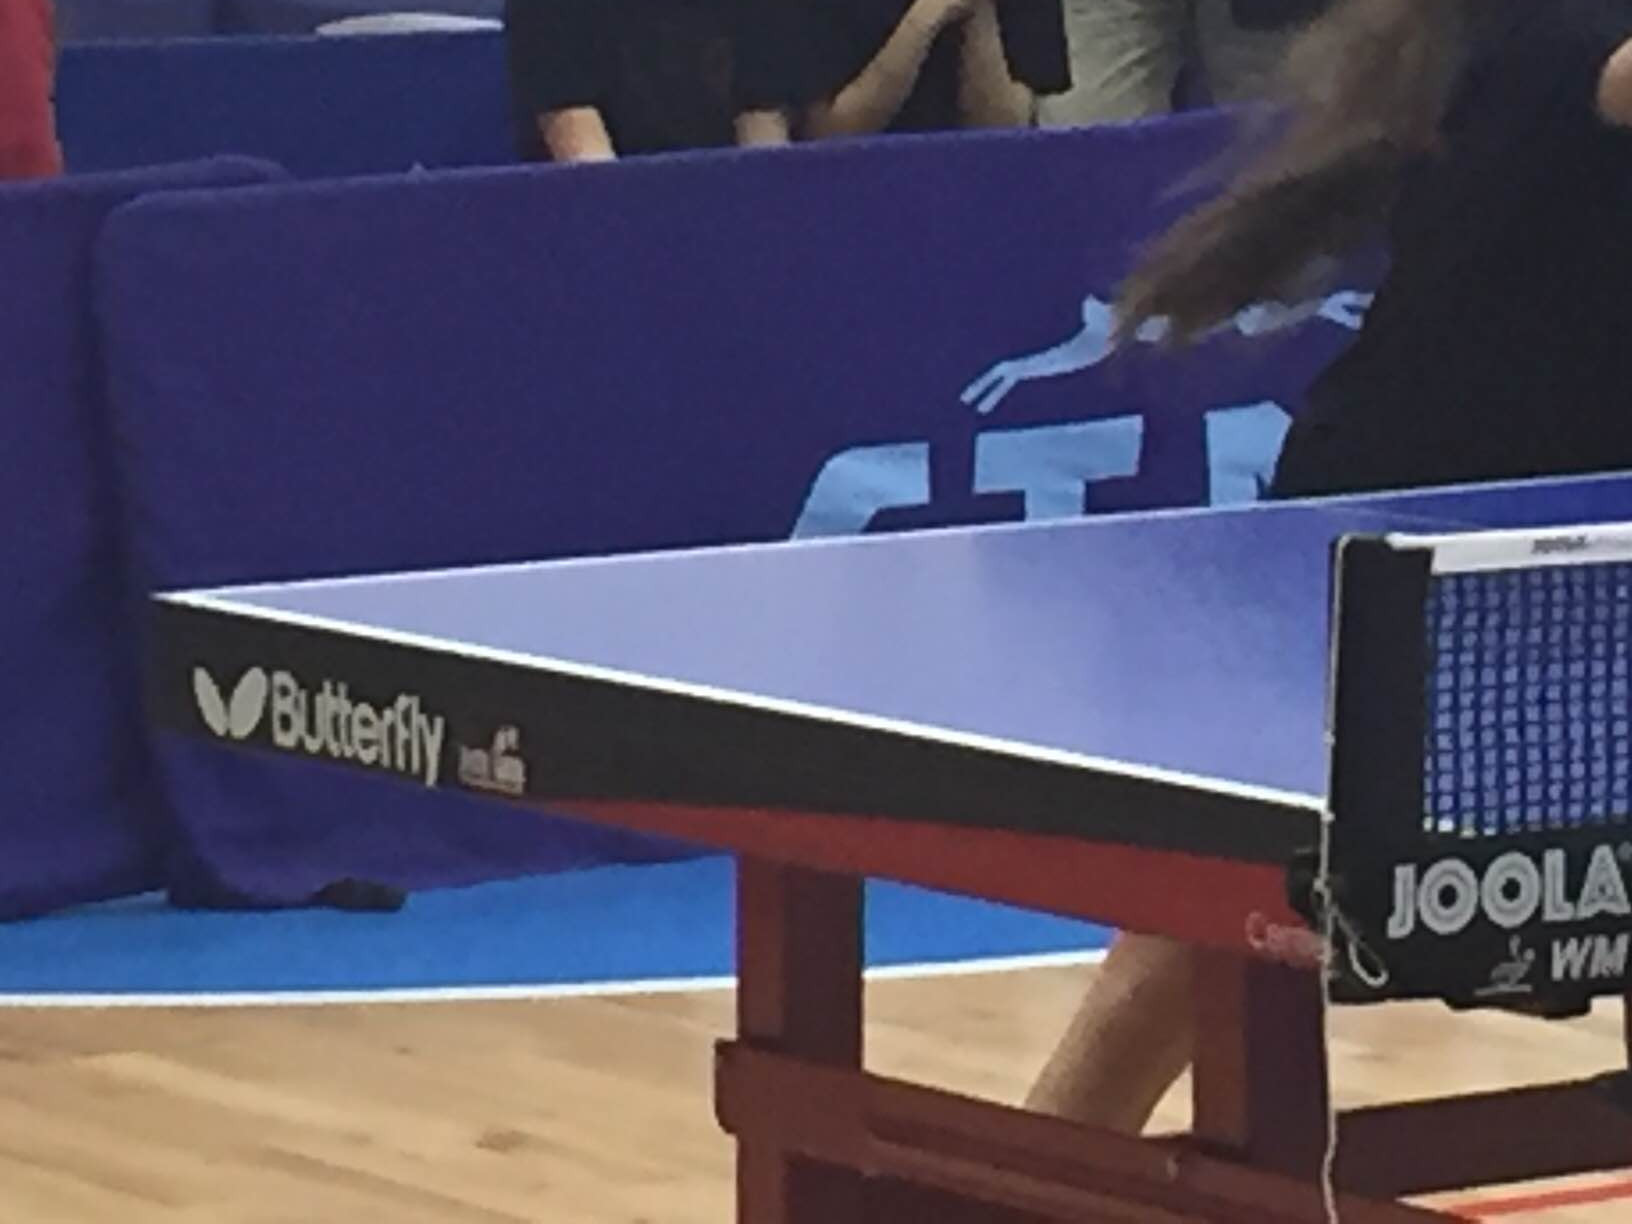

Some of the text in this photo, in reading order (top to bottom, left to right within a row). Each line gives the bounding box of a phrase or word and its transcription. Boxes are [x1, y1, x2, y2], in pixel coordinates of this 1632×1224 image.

[271, 670, 444, 788] Butterfly
[1387, 844, 1632, 939] JOOLA
[1551, 933, 1630, 981] WM
